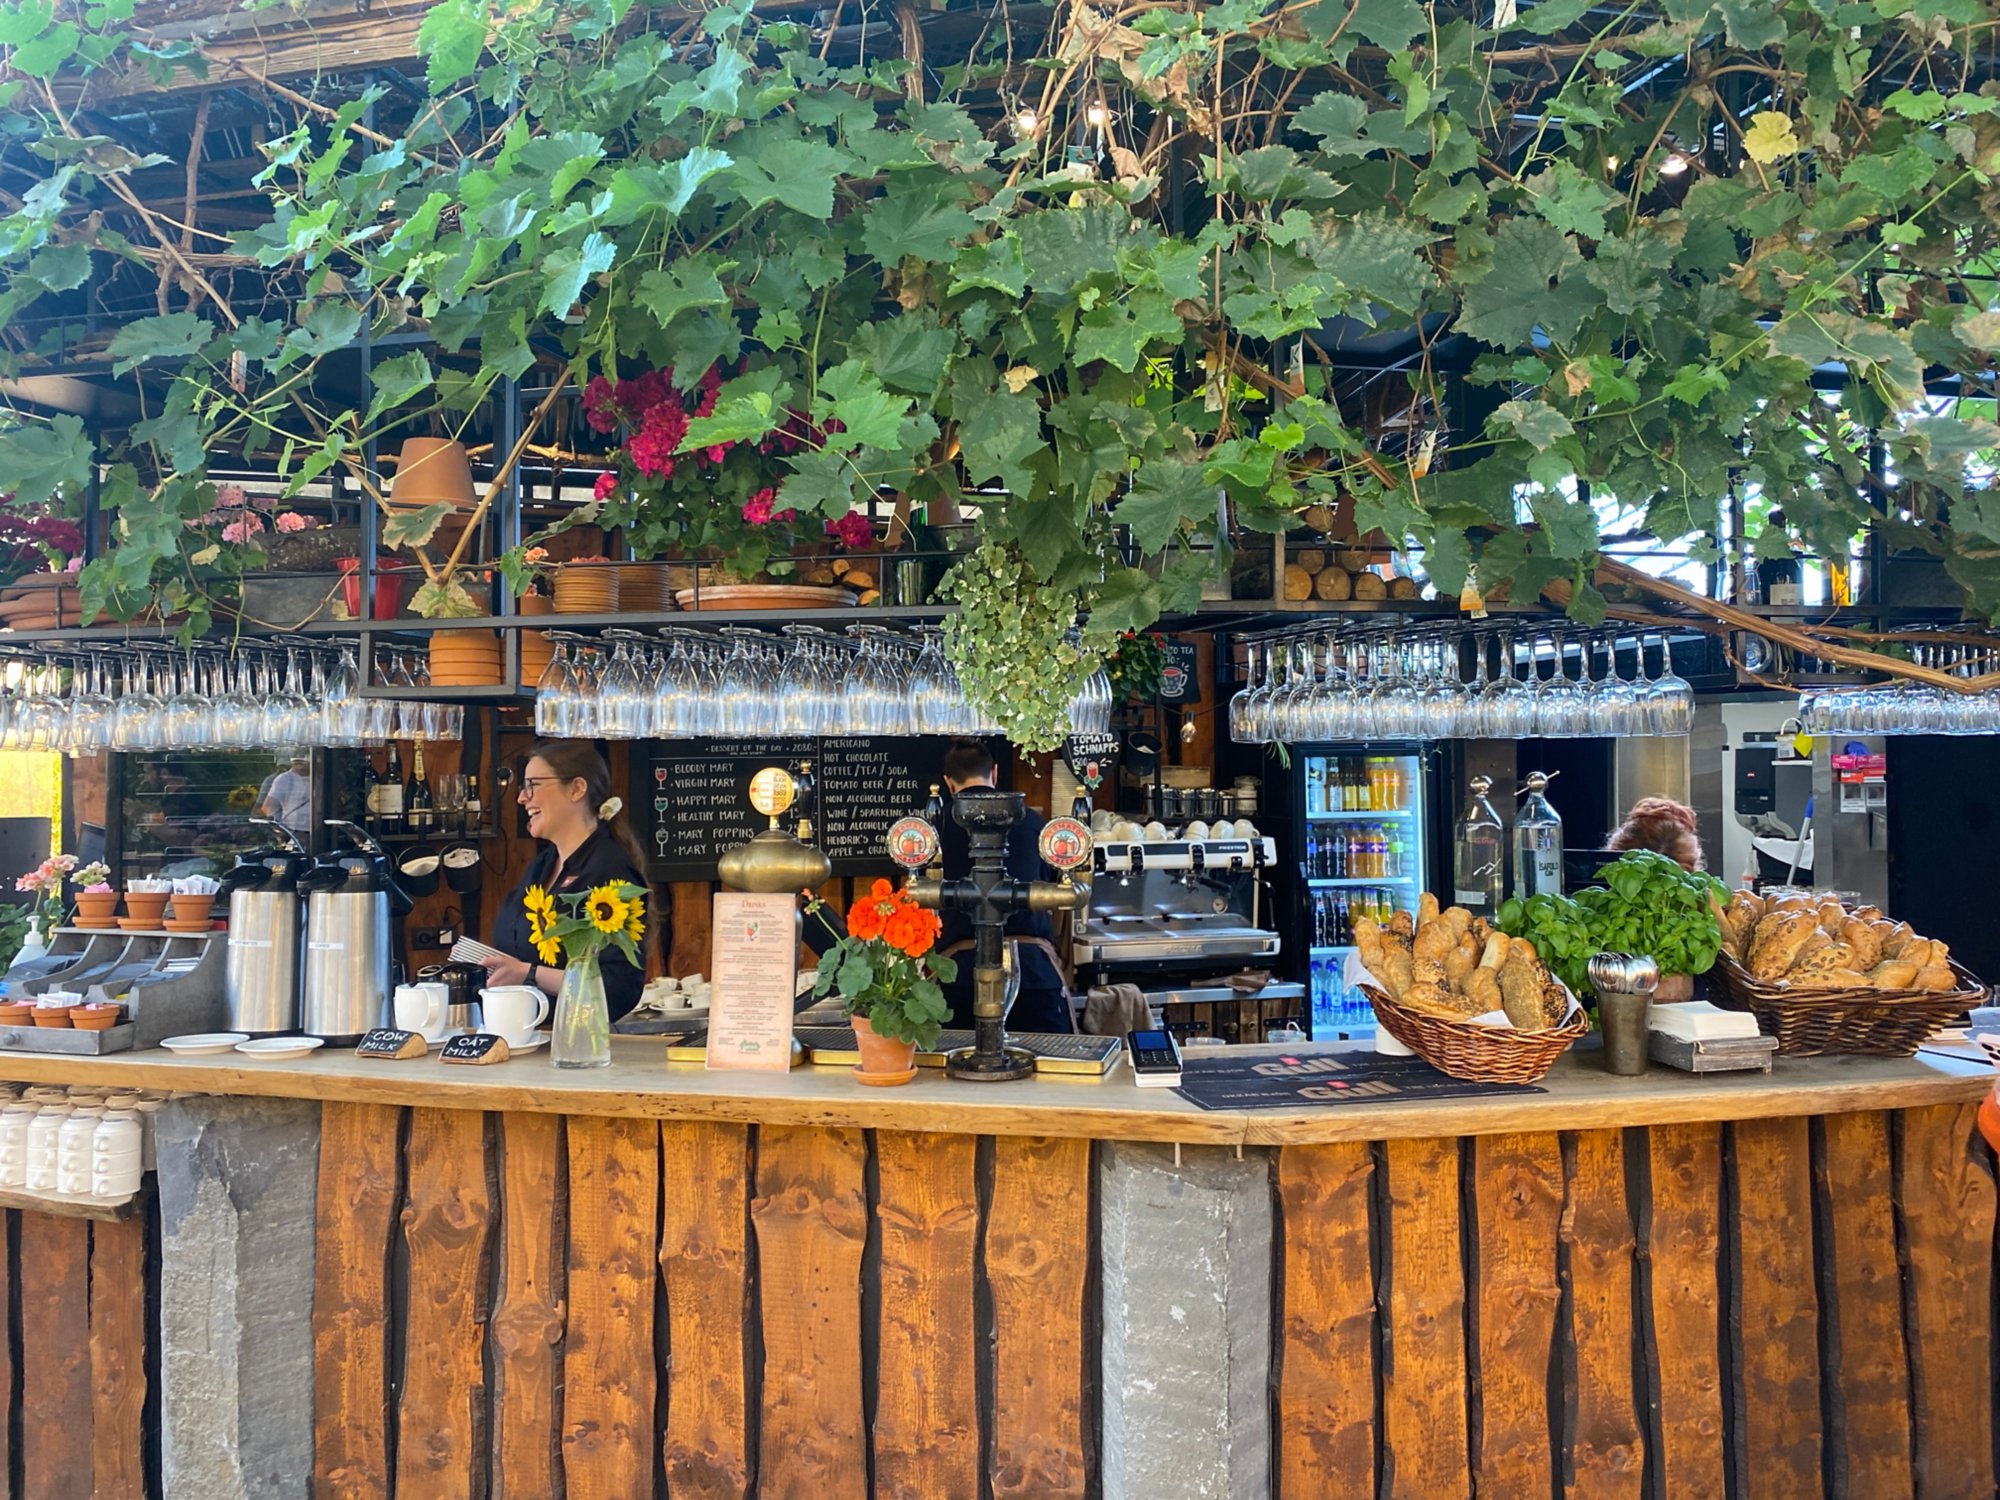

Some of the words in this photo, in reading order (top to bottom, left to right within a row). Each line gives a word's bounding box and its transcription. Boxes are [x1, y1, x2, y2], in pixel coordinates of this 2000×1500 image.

[824, 739, 870, 748] AMERICANO
[1070, 733, 1113, 744] TOMATO
[1073, 742, 1119, 756] SCHNAPPS
[824, 753, 839, 762] HOT
[845, 753, 889, 762] CHOCOLATE
[675, 763, 706, 773] BLOODY
[710, 763, 734, 772] MARY
[861, 766, 877, 775] TEA
[887, 766, 908, 775] SODA
[674, 779, 707, 789] VIRGIN
[710, 778, 735, 788] MARY
[824, 780, 858, 789] TOMATO
[862, 780, 884, 789] BEER
[897, 780, 918, 789] BEER
[676, 795, 708, 806] HAPPY
[711, 795, 736, 805] MARY
[825, 795, 842, 803] NON
[847, 794, 885, 803] ALCOHOLIC
[891, 794, 912, 803] BEER
[677, 811, 714, 822] HEALTHY
[719, 811, 745, 821] MARY
[827, 809, 848, 819] WINE
[860, 808, 904, 818] SPARKLING
[827, 823, 844, 832] NON
[850, 822, 888, 831] ALCOHOLIC
[678, 829, 704, 840] MARY
[712, 828, 754, 839] POPPINS
[678, 844, 706, 856] MARY
[828, 847, 852, 857] APPLE
[373, 1031, 407, 1041] COW
[363, 1041, 397, 1051] MILK
[458, 1036, 489, 1047] OAT
[444, 1048, 480, 1057] MILK
